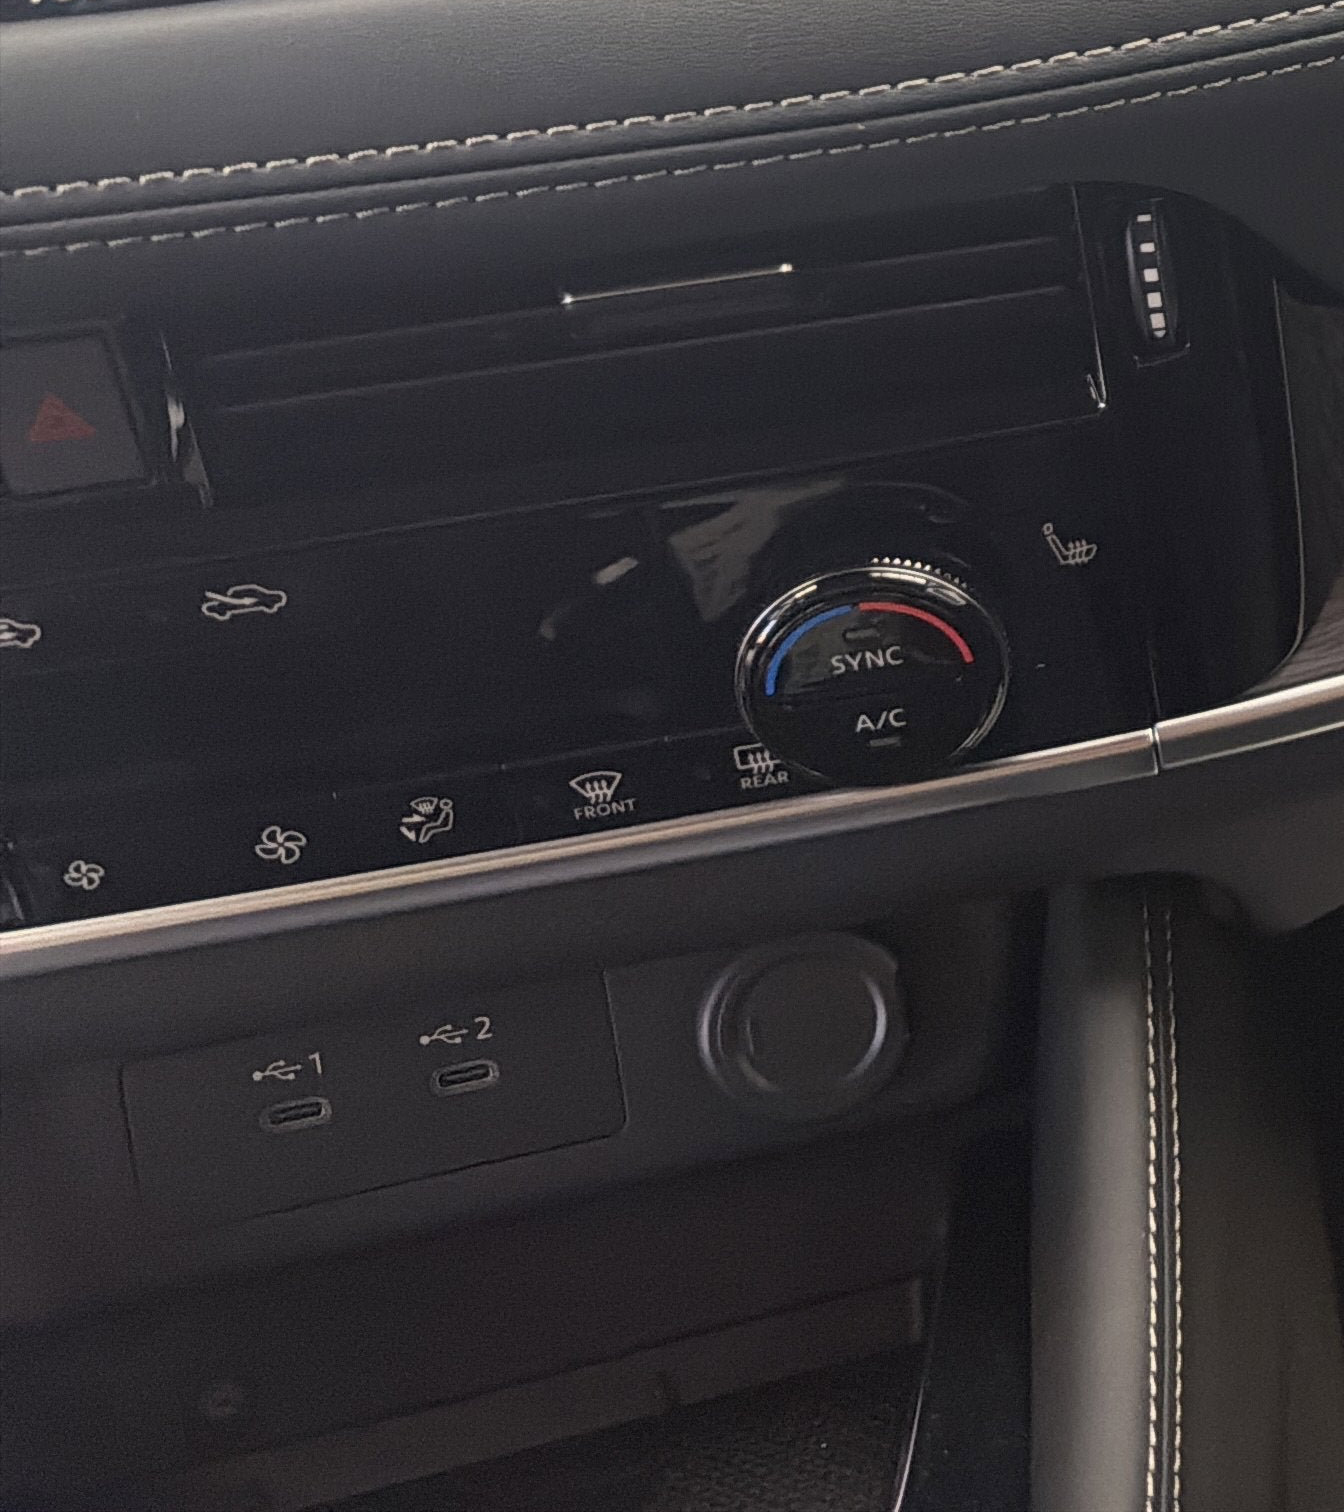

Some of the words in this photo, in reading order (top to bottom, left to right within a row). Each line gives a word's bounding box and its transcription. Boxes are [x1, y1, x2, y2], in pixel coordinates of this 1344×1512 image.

[830, 645, 905, 675] SYNC
[854, 708, 907, 733] A/C
[740, 770, 790, 789] REAR
[573, 797, 637, 821] FRONT
[473, 1016, 493, 1039] 2
[307, 1052, 323, 1075] 1
